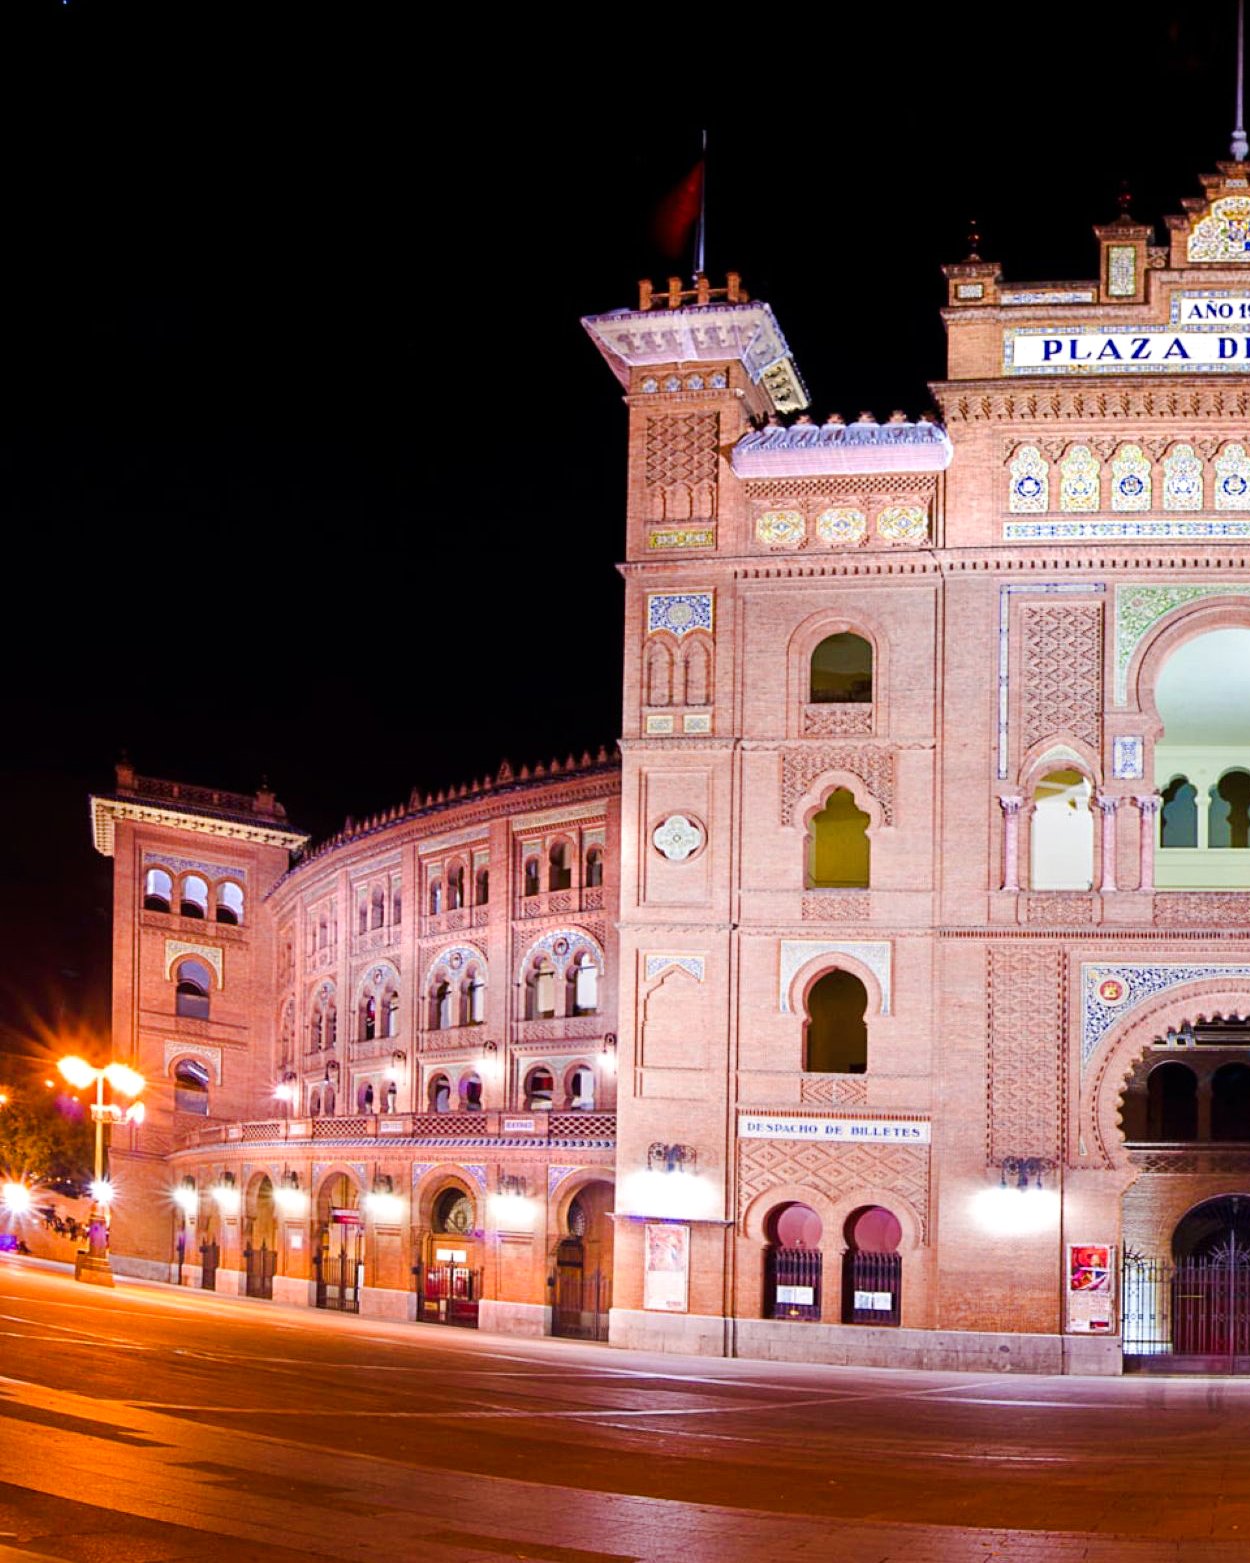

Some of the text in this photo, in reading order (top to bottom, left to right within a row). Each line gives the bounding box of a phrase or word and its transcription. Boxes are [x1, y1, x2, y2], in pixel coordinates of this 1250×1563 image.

[1188, 300, 1234, 319] AÑO
[1042, 337, 1190, 361] PLAZA
[746, 1122, 921, 1138] DESPACHO DE BILLETES
